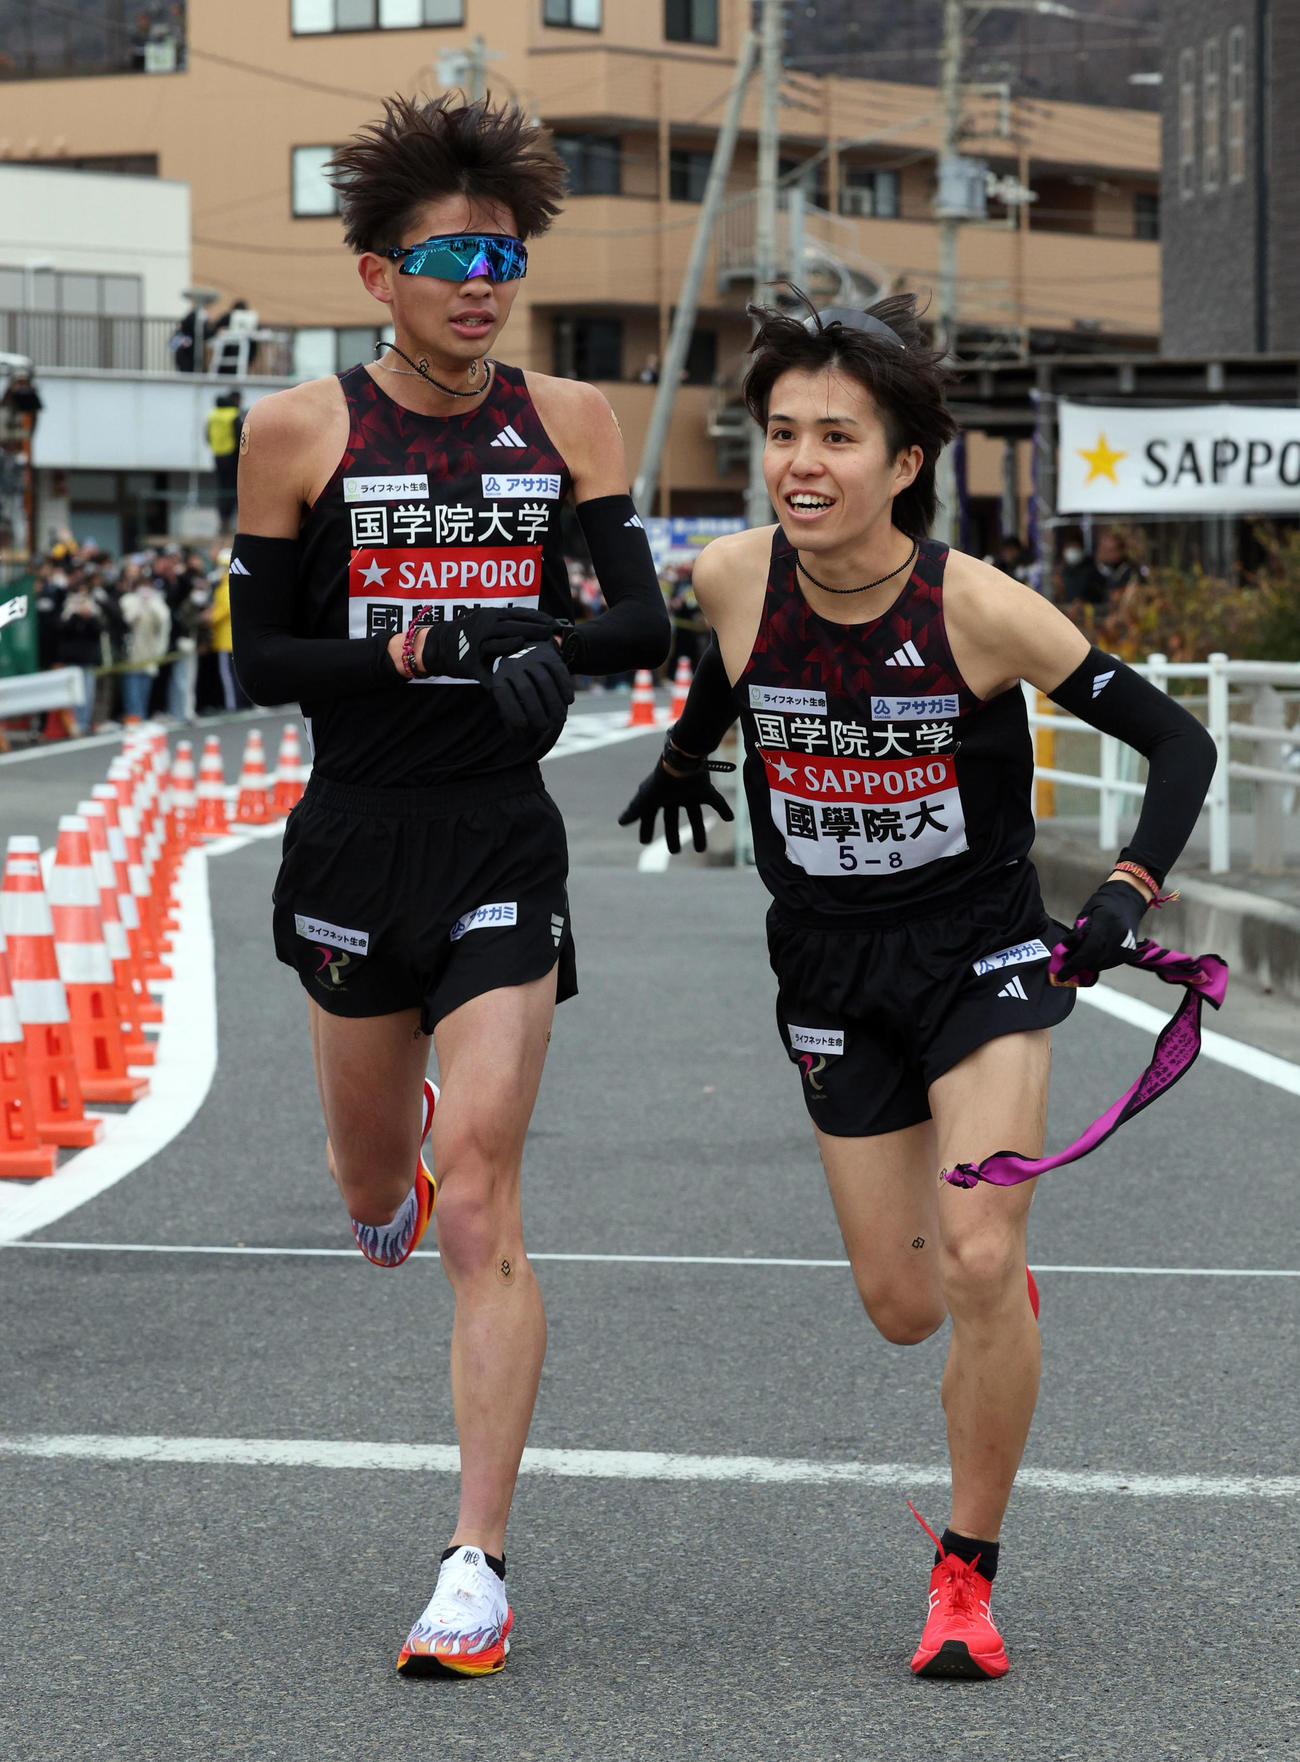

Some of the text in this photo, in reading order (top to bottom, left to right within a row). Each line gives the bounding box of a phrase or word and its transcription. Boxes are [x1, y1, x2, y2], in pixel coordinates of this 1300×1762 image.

[1144, 438, 1300, 487] SAPPO
[360, 482, 428, 493] ライフネット生命
[506, 478, 559, 493] アサガミ
[350, 503, 550, 547] 国学院大学
[398, 559, 536, 589] SAPPORO
[763, 693, 826, 707] ライフネット生命
[896, 698, 957, 715] アサガミ
[753, 713, 953, 758] 国学院大学
[803, 761, 947, 795] SAPPORO
[784, 798, 949, 843] 國學院大
[308, 924, 367, 948] ライフネット生命
[996, 942, 1047, 967] アサガミ
[795, 1033, 843, 1047] ライフネット生命
